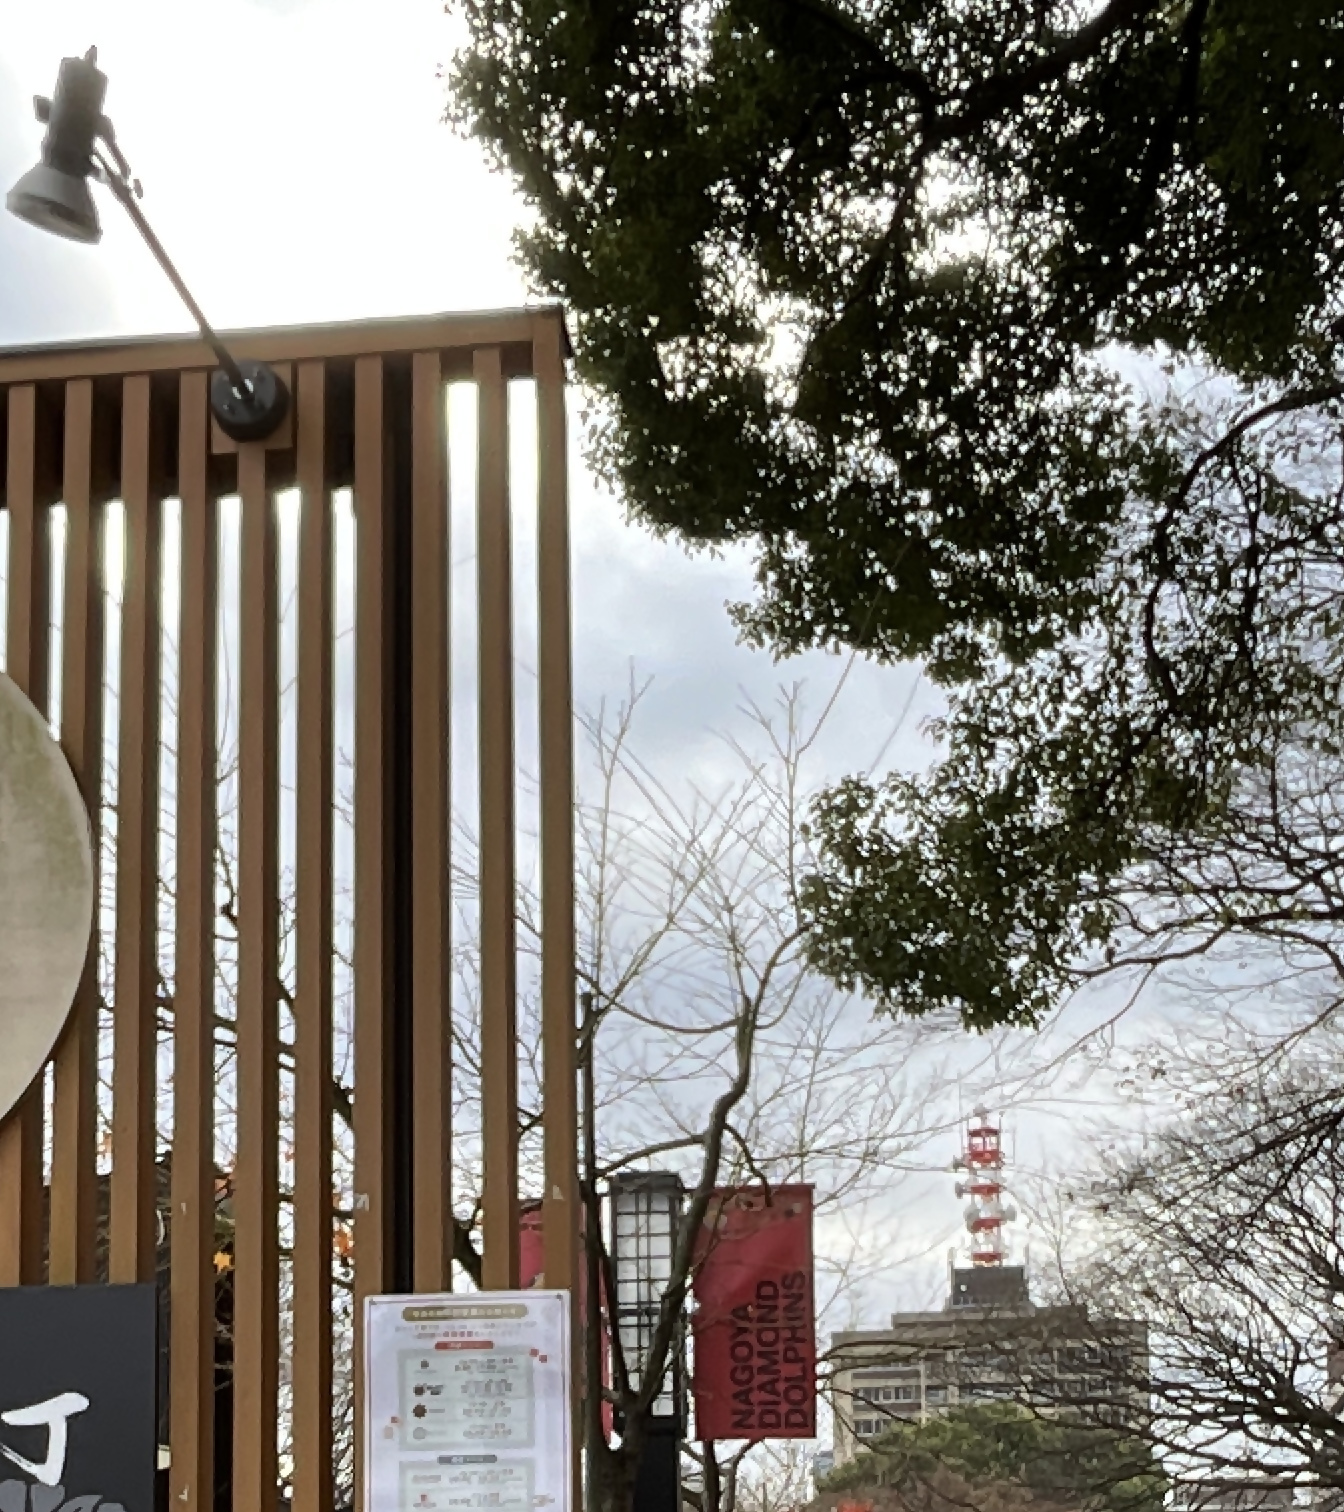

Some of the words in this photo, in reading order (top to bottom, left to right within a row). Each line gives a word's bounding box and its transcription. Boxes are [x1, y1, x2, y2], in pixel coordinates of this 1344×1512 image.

[730, 1303, 756, 1430] NAGOYA
[758, 1279, 781, 1430] DIAMOND
[782, 1270, 808, 1429] DOLPHINS
